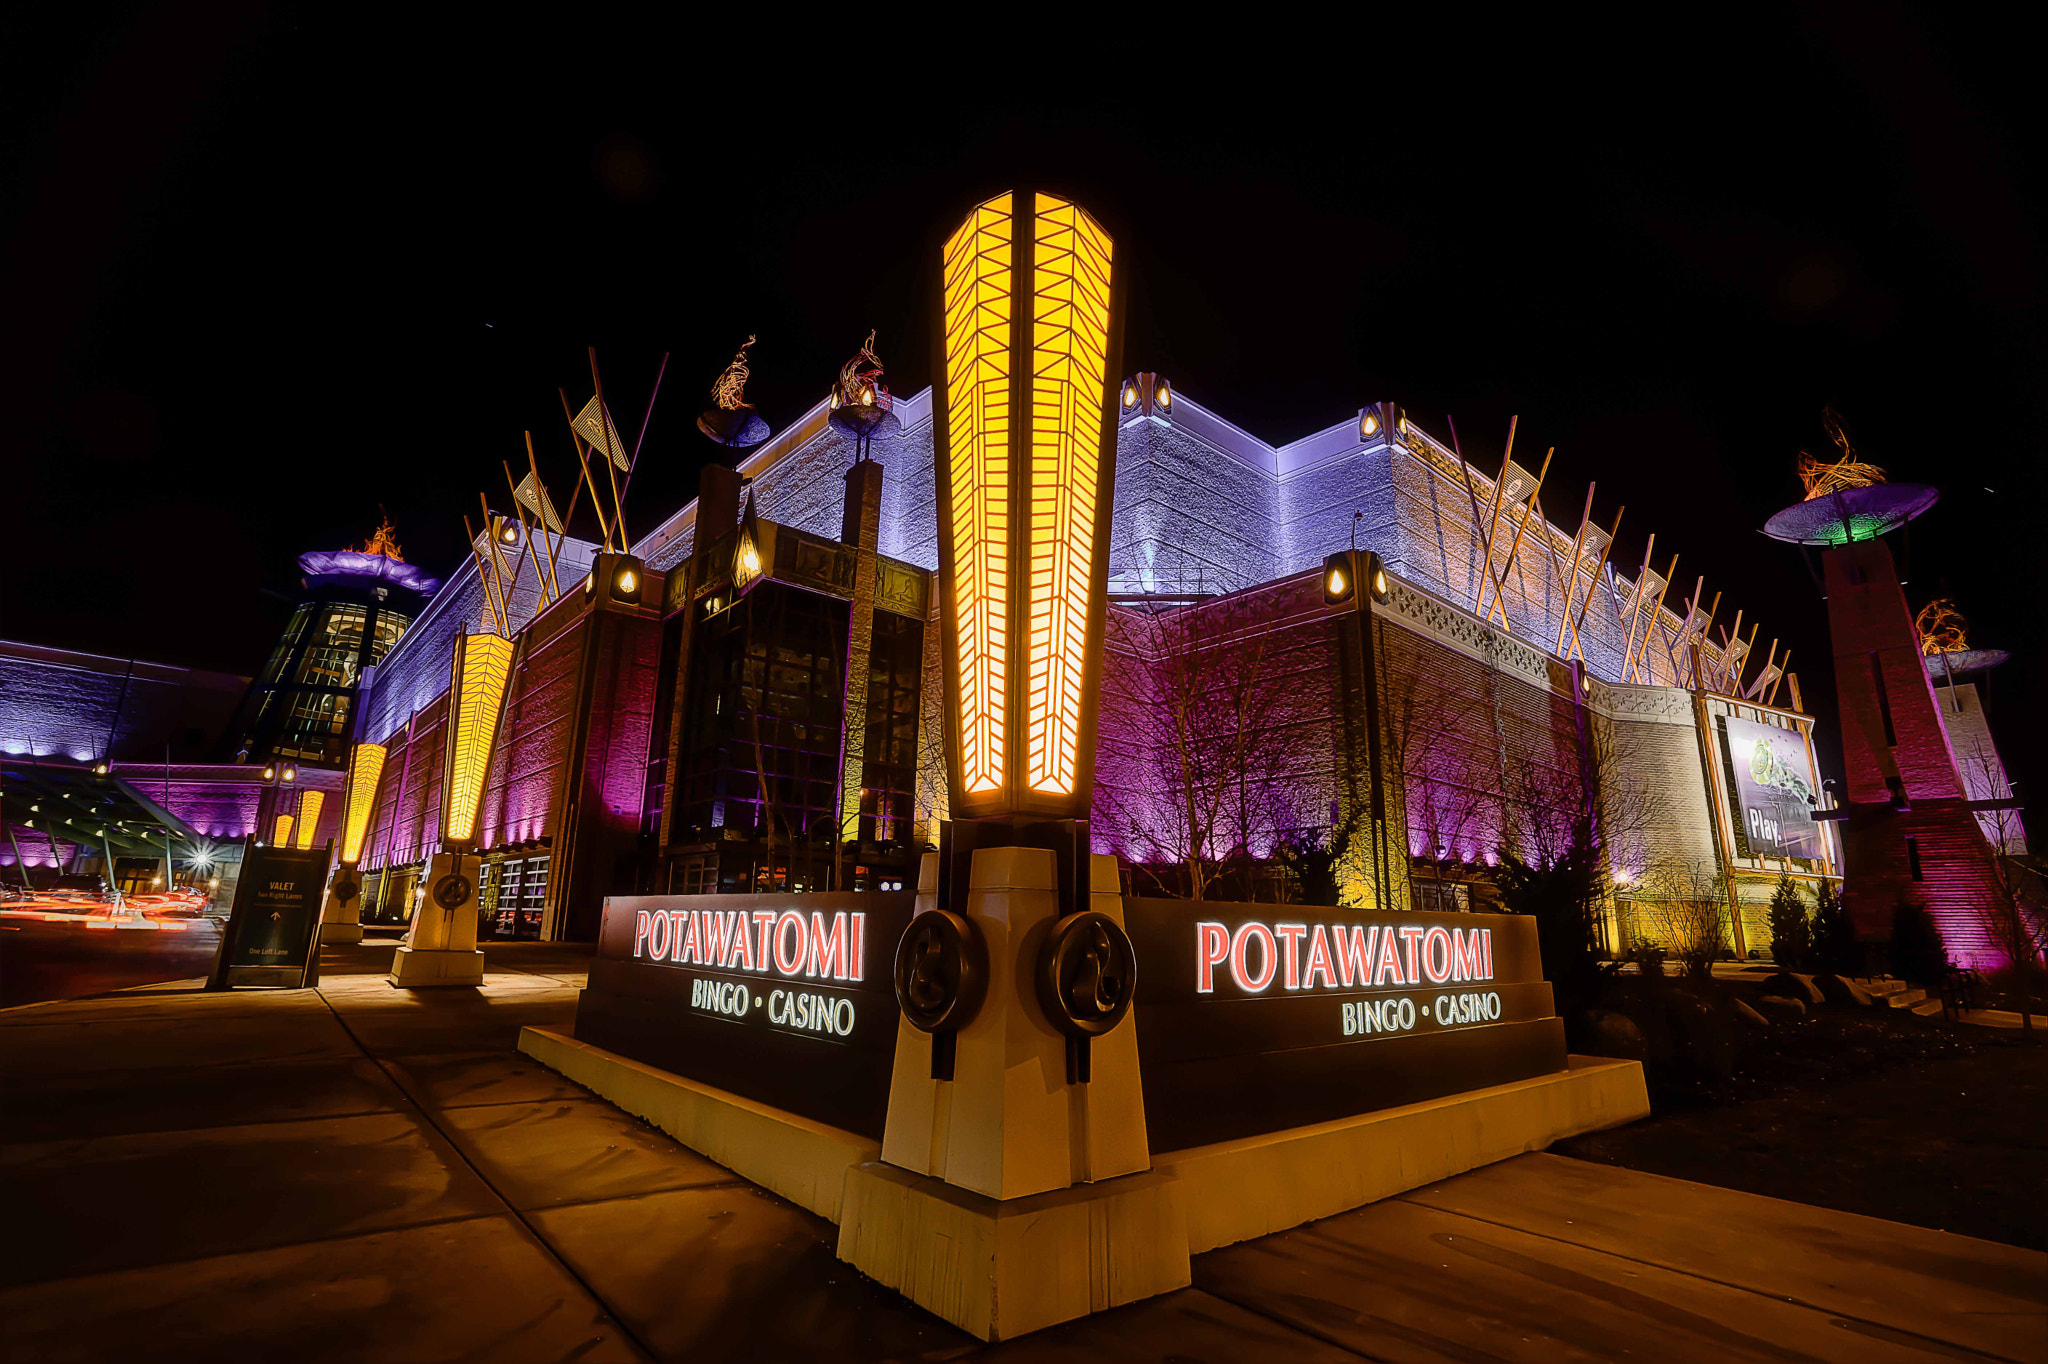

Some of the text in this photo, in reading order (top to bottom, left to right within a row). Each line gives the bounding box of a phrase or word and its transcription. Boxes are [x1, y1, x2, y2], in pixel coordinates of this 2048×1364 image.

[1749, 808, 1782, 848] Play.
[269, 881, 294, 891] VALET
[633, 910, 866, 982] POTAWATOMI
[1196, 921, 1494, 993] POTAWATOMI
[691, 978, 855, 1036] BINGO CASINO
[1341, 991, 1502, 1036] BINGO CASINO
